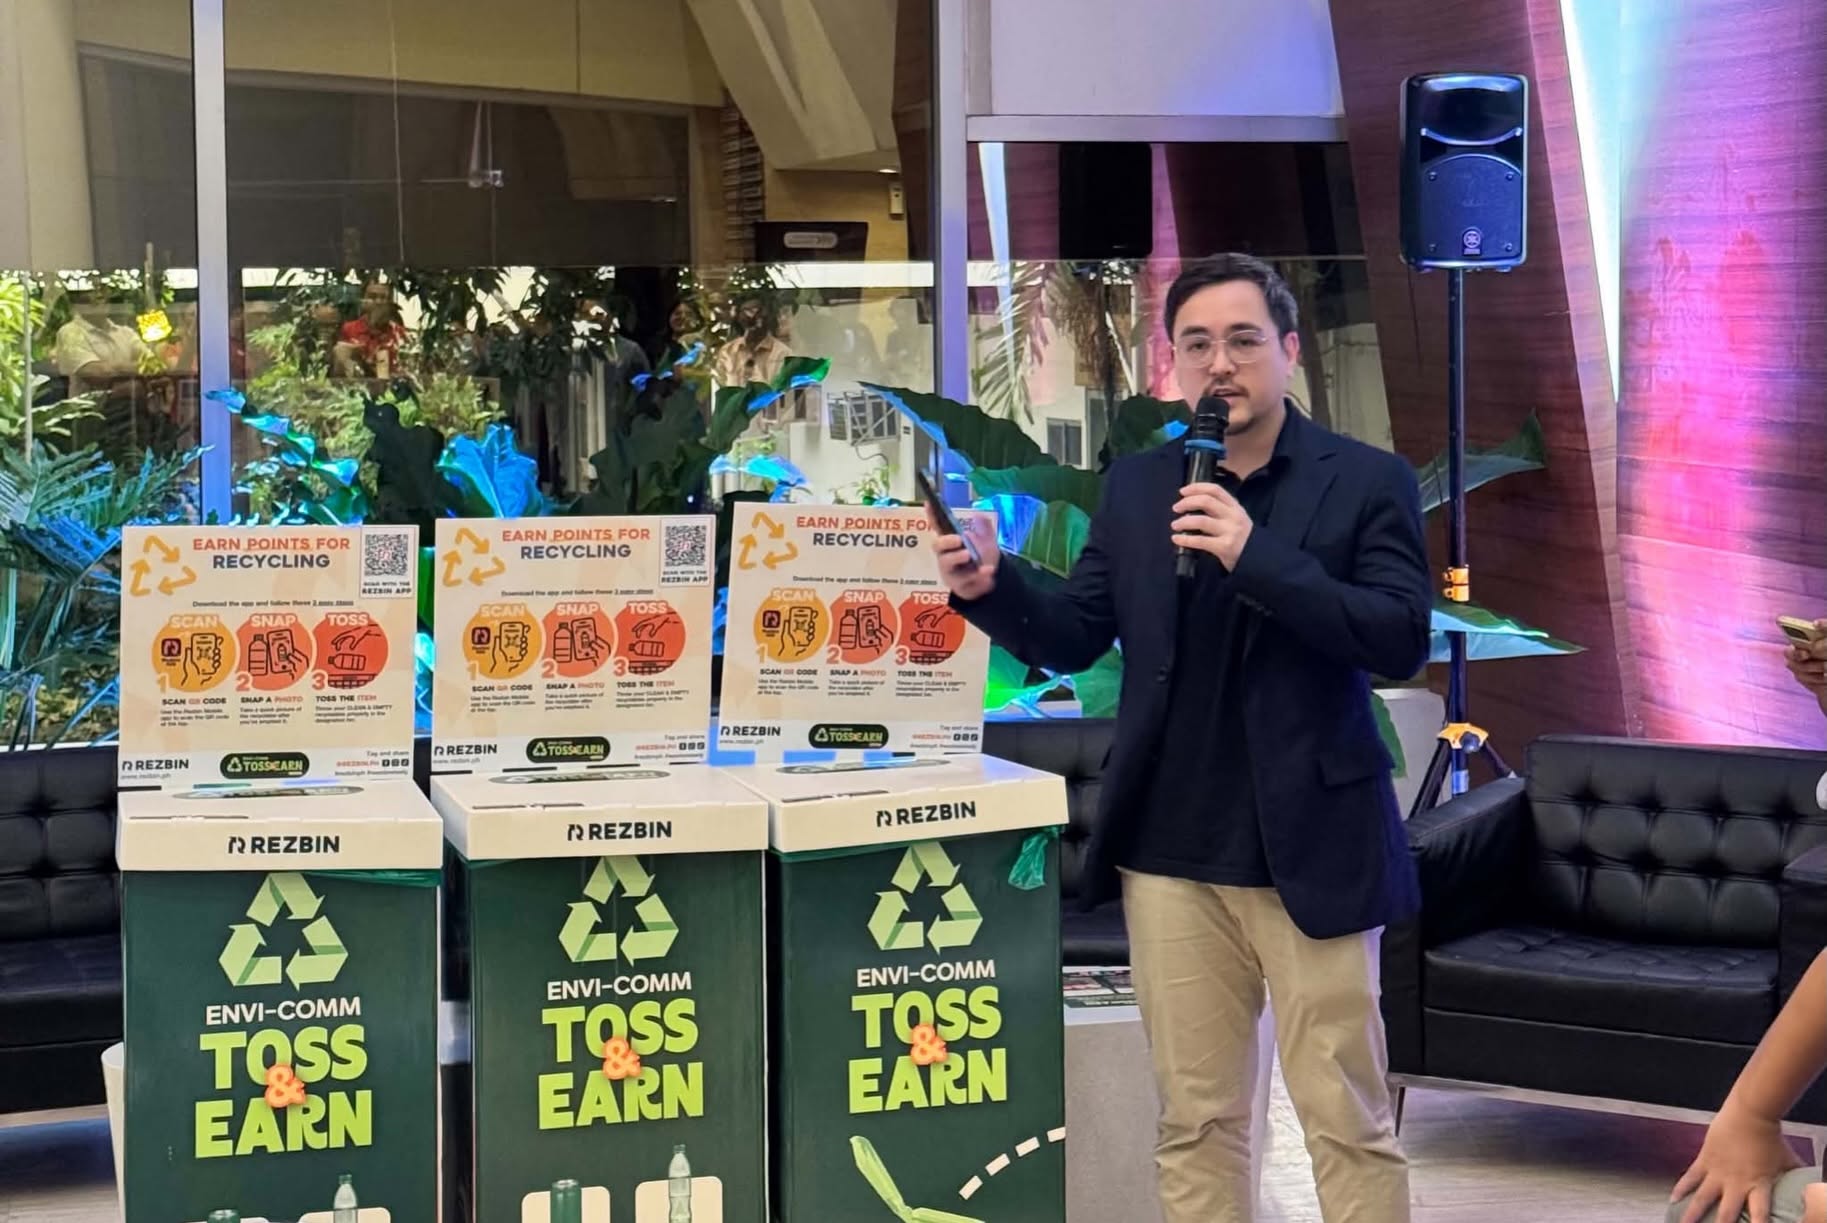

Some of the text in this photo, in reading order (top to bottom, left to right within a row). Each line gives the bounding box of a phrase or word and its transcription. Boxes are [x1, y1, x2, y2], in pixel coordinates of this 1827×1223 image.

[796, 517, 932, 531] EARN POINTS FO
[193, 537, 350, 550] EARN POINTS FOR
[502, 528, 650, 542] EARN POINTS FOR
[813, 533, 918, 548] RECYCLING
[521, 545, 631, 559] RECYCLING
[213, 554, 330, 569] RECYCLING
[771, 588, 815, 602] SCAN
[843, 590, 885, 603] SNAP
[913, 592, 949, 605] TOSS
[480, 603, 525, 618] SCAN
[556, 602, 600, 615] SNAP
[628, 601, 668, 614] TOSS
[171, 614, 218, 629] SCAN
[251, 613, 297, 628] SNAP
[328, 613, 369, 626] TOSS
[756, 645, 768, 664] 1
[826, 646, 841, 664] 2
[895, 647, 910, 665] 3
[467, 662, 480, 680] 1
[541, 661, 555, 679] 2
[613, 658, 628, 676] 3
[157, 675, 169, 693] 1
[236, 675, 250, 692] 2
[312, 673, 326, 690] 3
[202, 697, 227, 705] CODE
[732, 726, 781, 737] REZBIN
[447, 744, 498, 756] REZBIN
[135, 759, 189, 771] REZBIN
[896, 801, 976, 825] REZBIN
[588, 821, 672, 841] REZBIN
[251, 836, 340, 854] REZBIN
[856, 959, 996, 988] ENVI-COMM
[547, 971, 692, 1000] ENVI-COMM
[206, 997, 361, 1025] ENVI-COMM
[851, 985, 1002, 1049] TOSS
[542, 998, 699, 1063] TOSS
[910, 1023, 948, 1065] &
[200, 1024, 368, 1090] TOSS
[602, 1037, 641, 1080] &
[264, 1064, 306, 1108] &
[848, 1047, 1007, 1114] EARN
[538, 1061, 704, 1130] EARN
[195, 1089, 373, 1159] EARN
